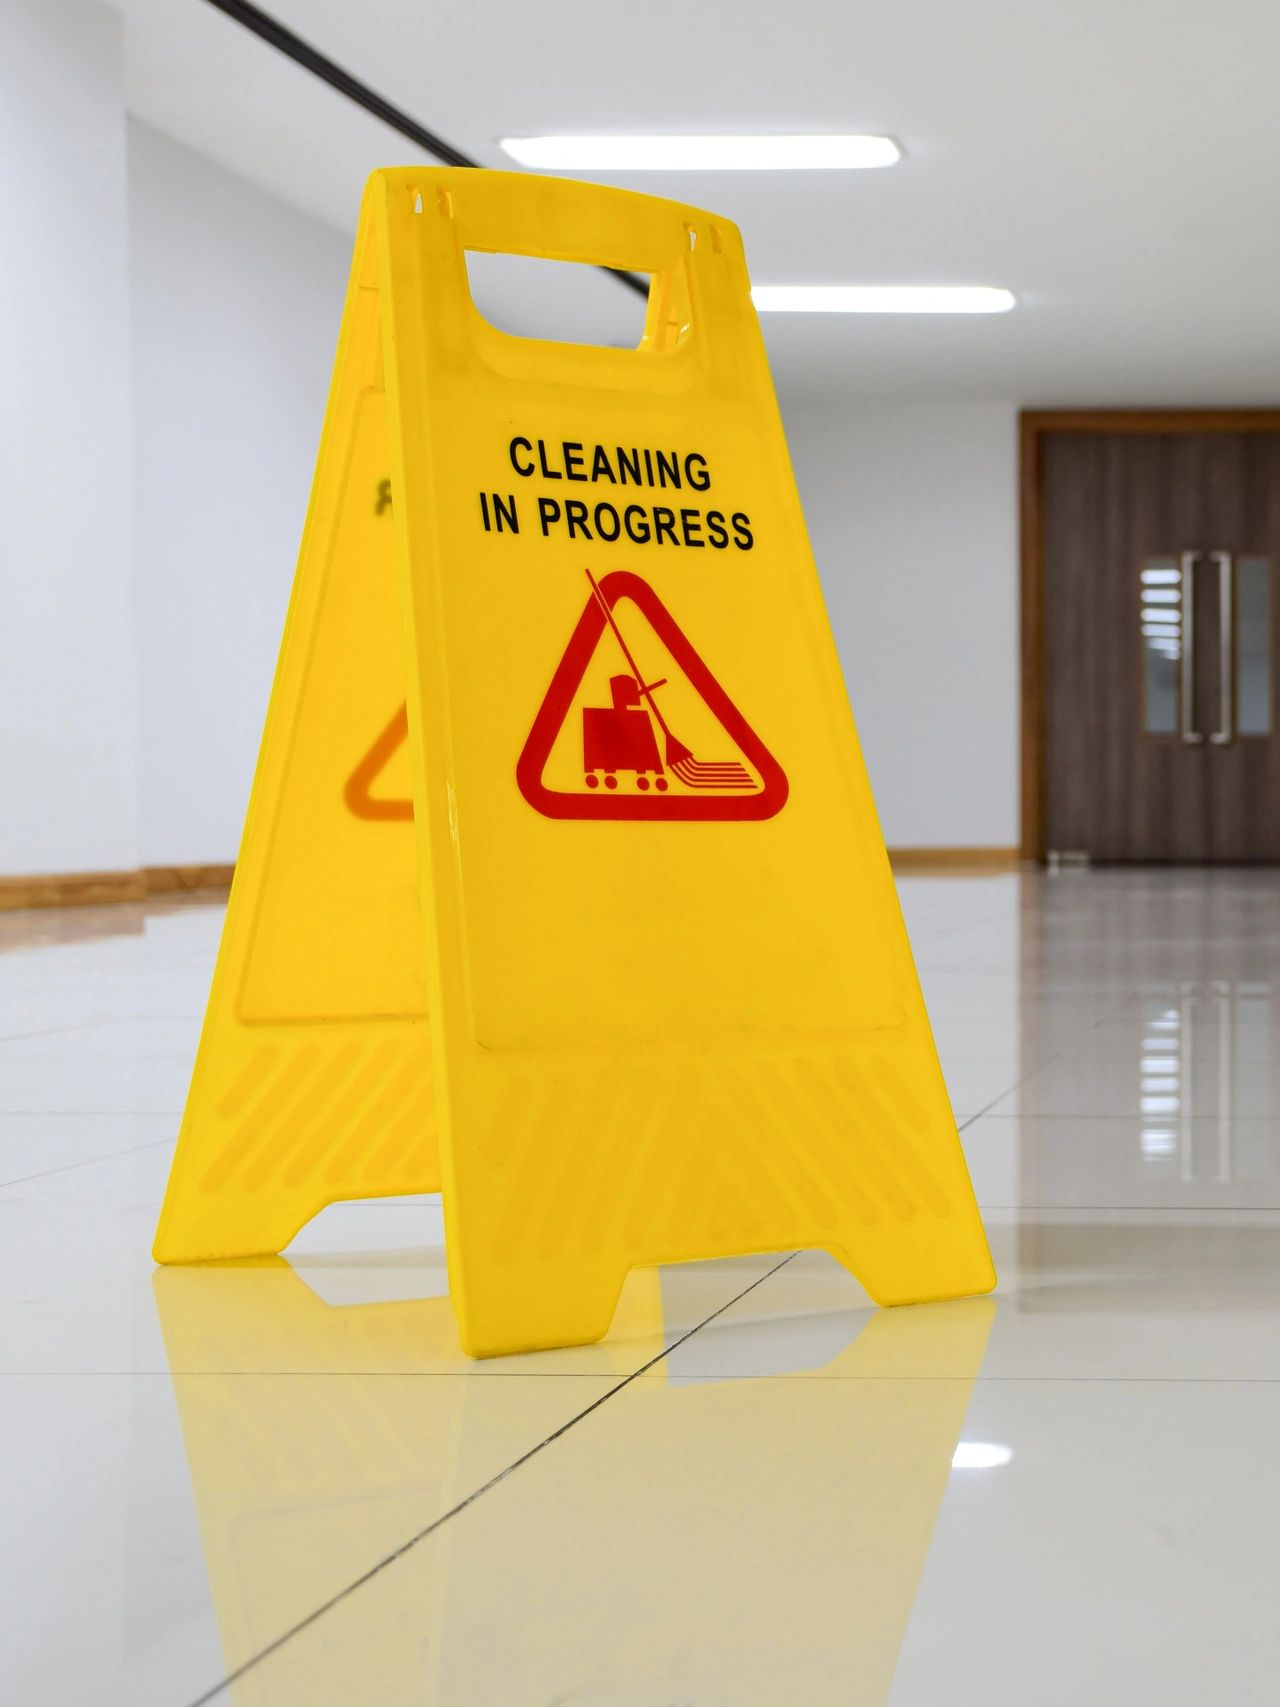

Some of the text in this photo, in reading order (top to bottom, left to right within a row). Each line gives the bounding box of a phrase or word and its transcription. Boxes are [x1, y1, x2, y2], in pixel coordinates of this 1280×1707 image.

[509, 436, 711, 491] CLEANING
[479, 492, 754, 551] IN PROGRESS
